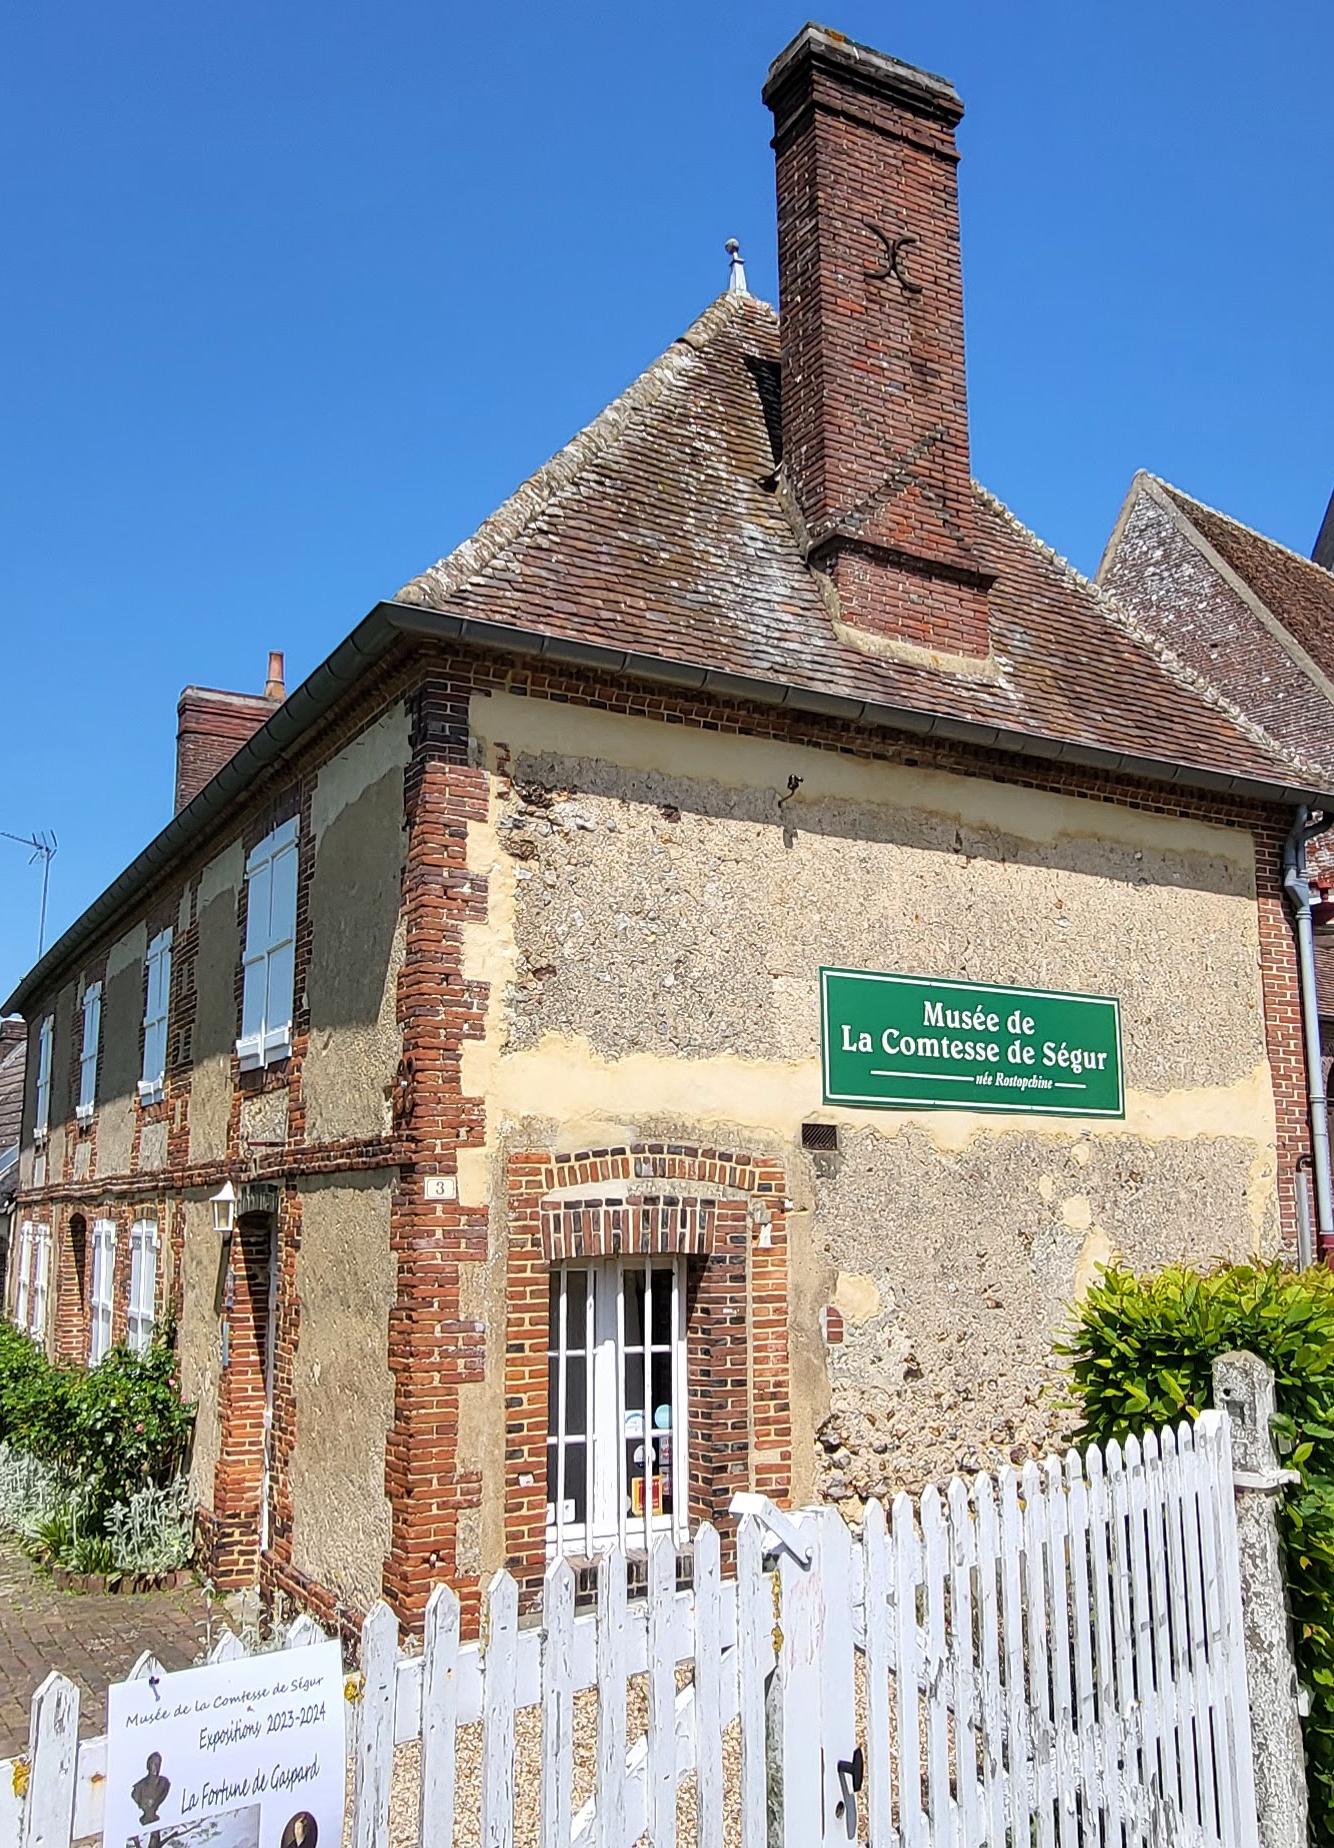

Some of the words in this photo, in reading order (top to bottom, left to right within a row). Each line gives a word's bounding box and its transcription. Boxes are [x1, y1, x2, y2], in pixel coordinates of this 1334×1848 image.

[922, 1000, 1000, 1032] Musée
[1006, 1010, 1036, 1035] de
[841, 1024, 873, 1053] La
[881, 1028, 1000, 1063] Comtesse
[1006, 1039, 1036, 1065] de
[1041, 1041, 1108, 1073] Ségur
[975, 1072, 993, 1086] née
[994, 1072, 1053, 1091] Rostopchine
[435, 1181, 445, 1195] 3
[125, 1710, 170, 1728] Musée
[173, 1703, 191, 1718] de
[194, 1700, 210, 1712] la
[212, 1687, 270, 1709] Comtesse
[272, 1683, 289, 1699] de
[290, 1675, 325, 1695] Ségur
[199, 1717, 262, 1752] Expositions
[266, 1701, 326, 1735] 2023-2024
[181, 1788, 199, 1815] La
[202, 1776, 249, 1810] Fortune
[251, 1767, 268, 1795] de
[270, 1753, 321, 1793] Gaspard
